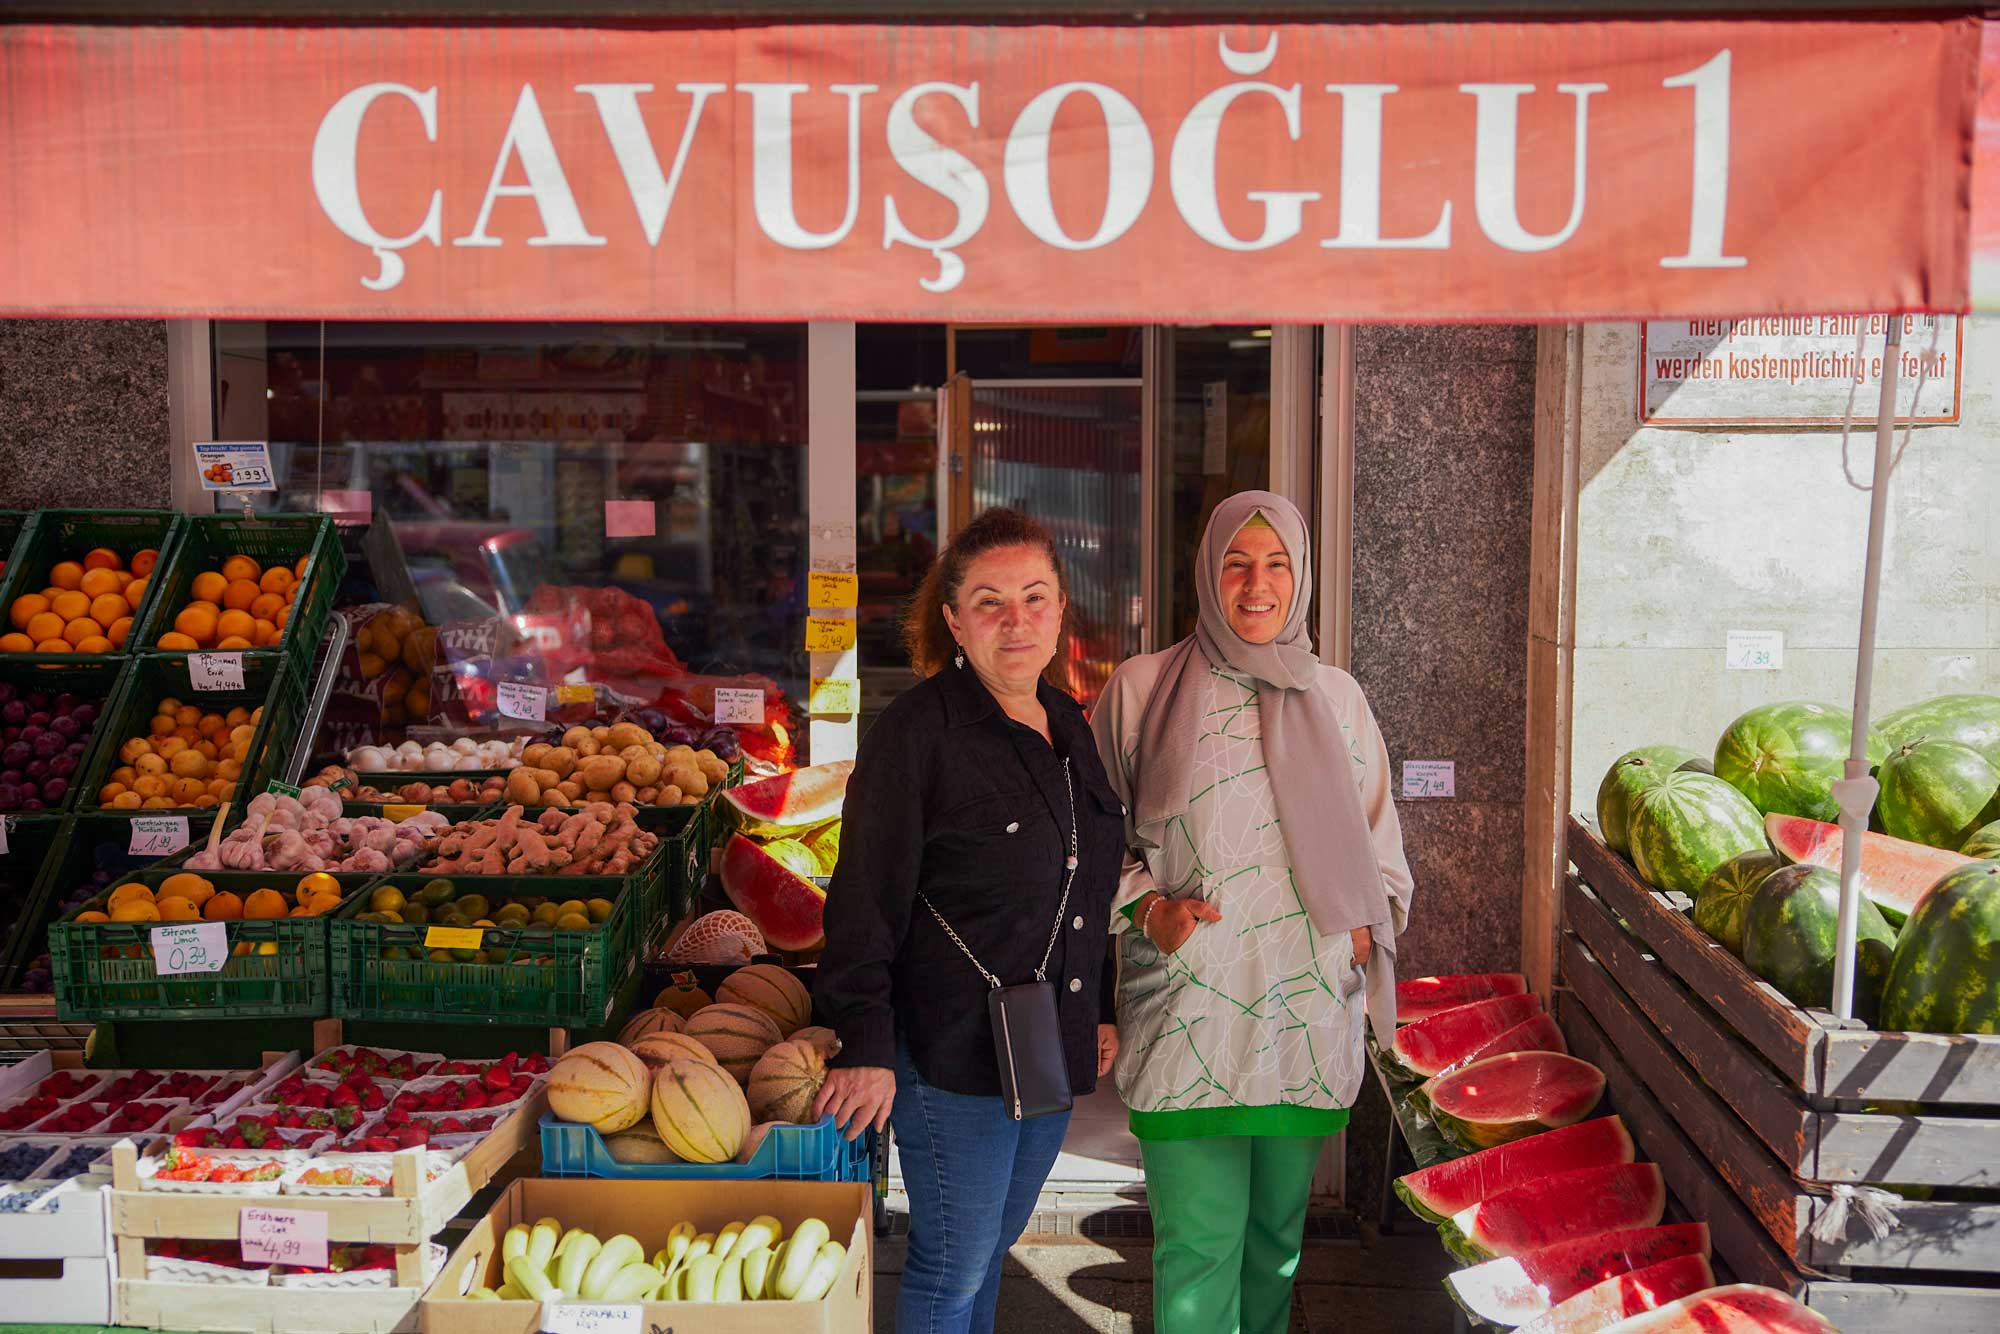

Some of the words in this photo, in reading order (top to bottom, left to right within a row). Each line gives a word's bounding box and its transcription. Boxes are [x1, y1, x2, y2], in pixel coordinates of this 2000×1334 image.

[312, 31, 1608, 293] ÇAVUŞOĞLU
[1660, 48, 1748, 269] 1
[1656, 351, 1722, 379] werden
[1729, 351, 1867, 385] kostenpflichtig
[1871, 351, 1948, 378] efernt
[161, 928, 198, 937] Zitrone
[169, 946, 207, 970] 0,39
[263, 1237, 300, 1260] 4,99
